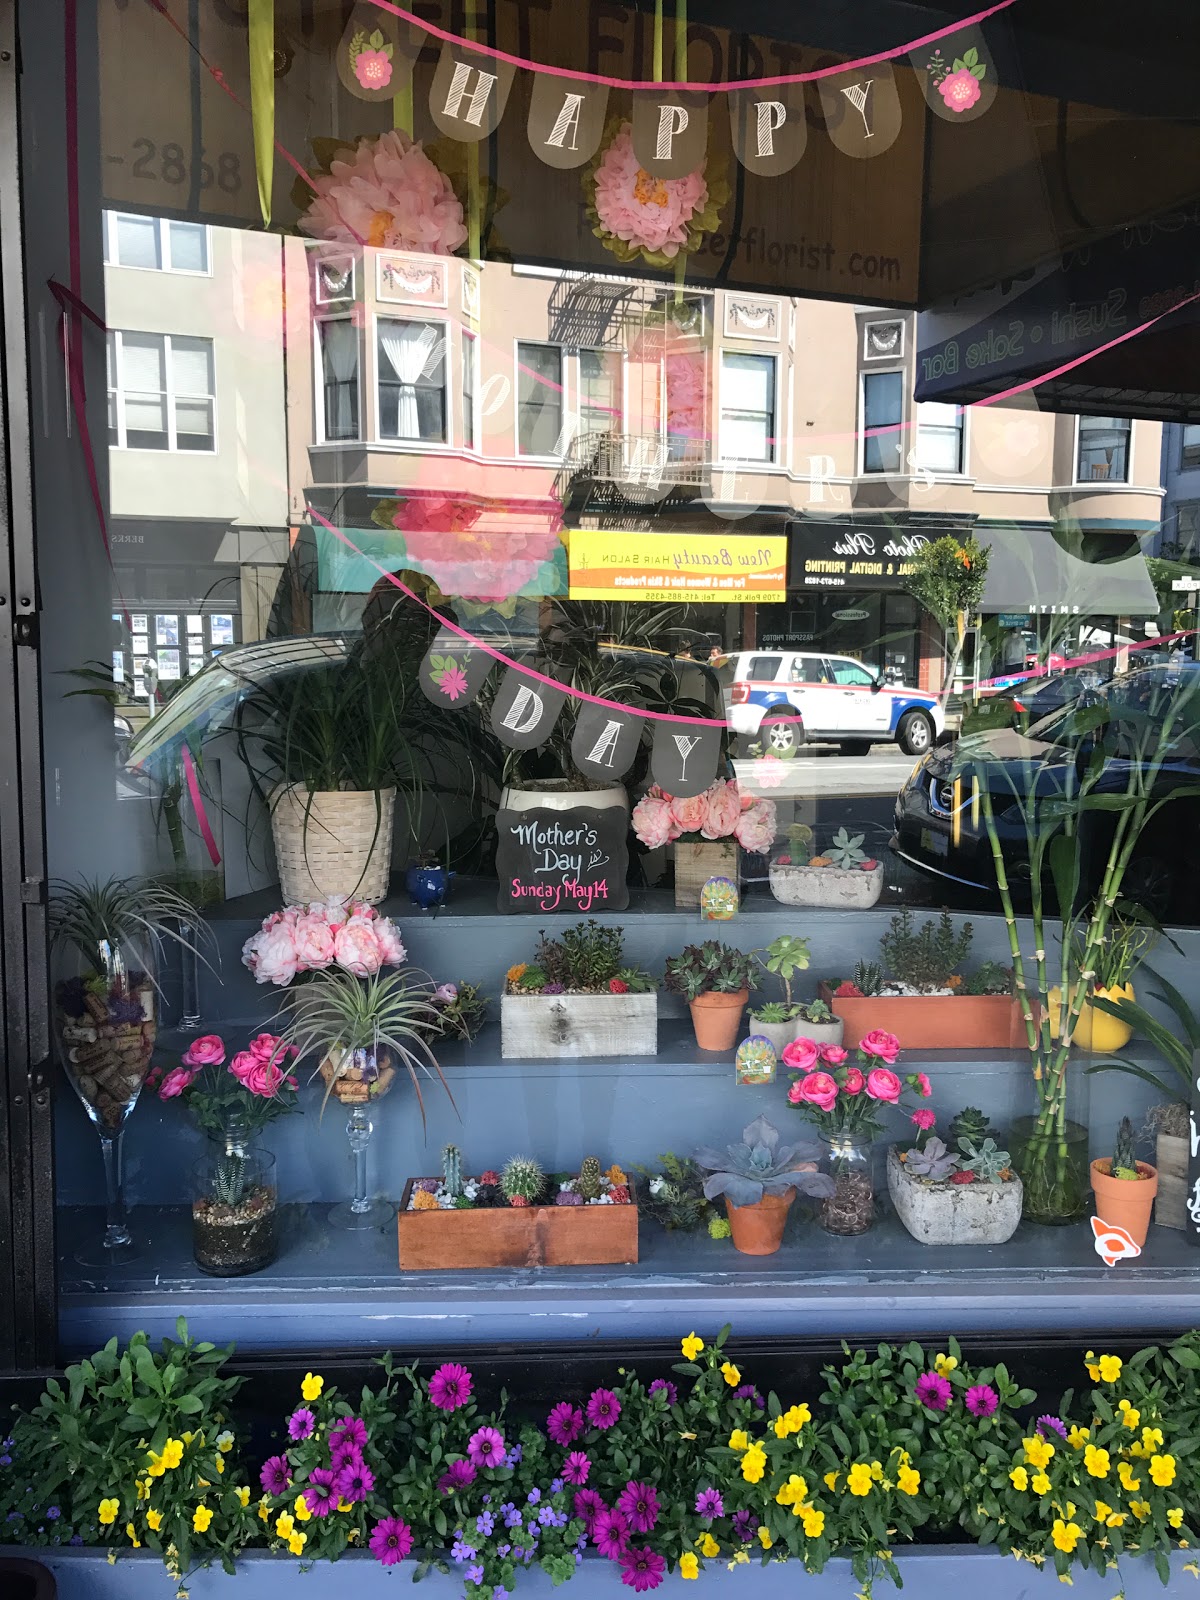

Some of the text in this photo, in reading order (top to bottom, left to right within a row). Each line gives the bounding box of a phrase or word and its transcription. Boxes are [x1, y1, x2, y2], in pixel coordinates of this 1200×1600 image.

[442, 61, 874, 161] HAPPY
[499, 684, 703, 782] DAY
[511, 821, 598, 854] Mother's
[534, 848, 582, 886] Day
[511, 878, 562, 911] Sunday
